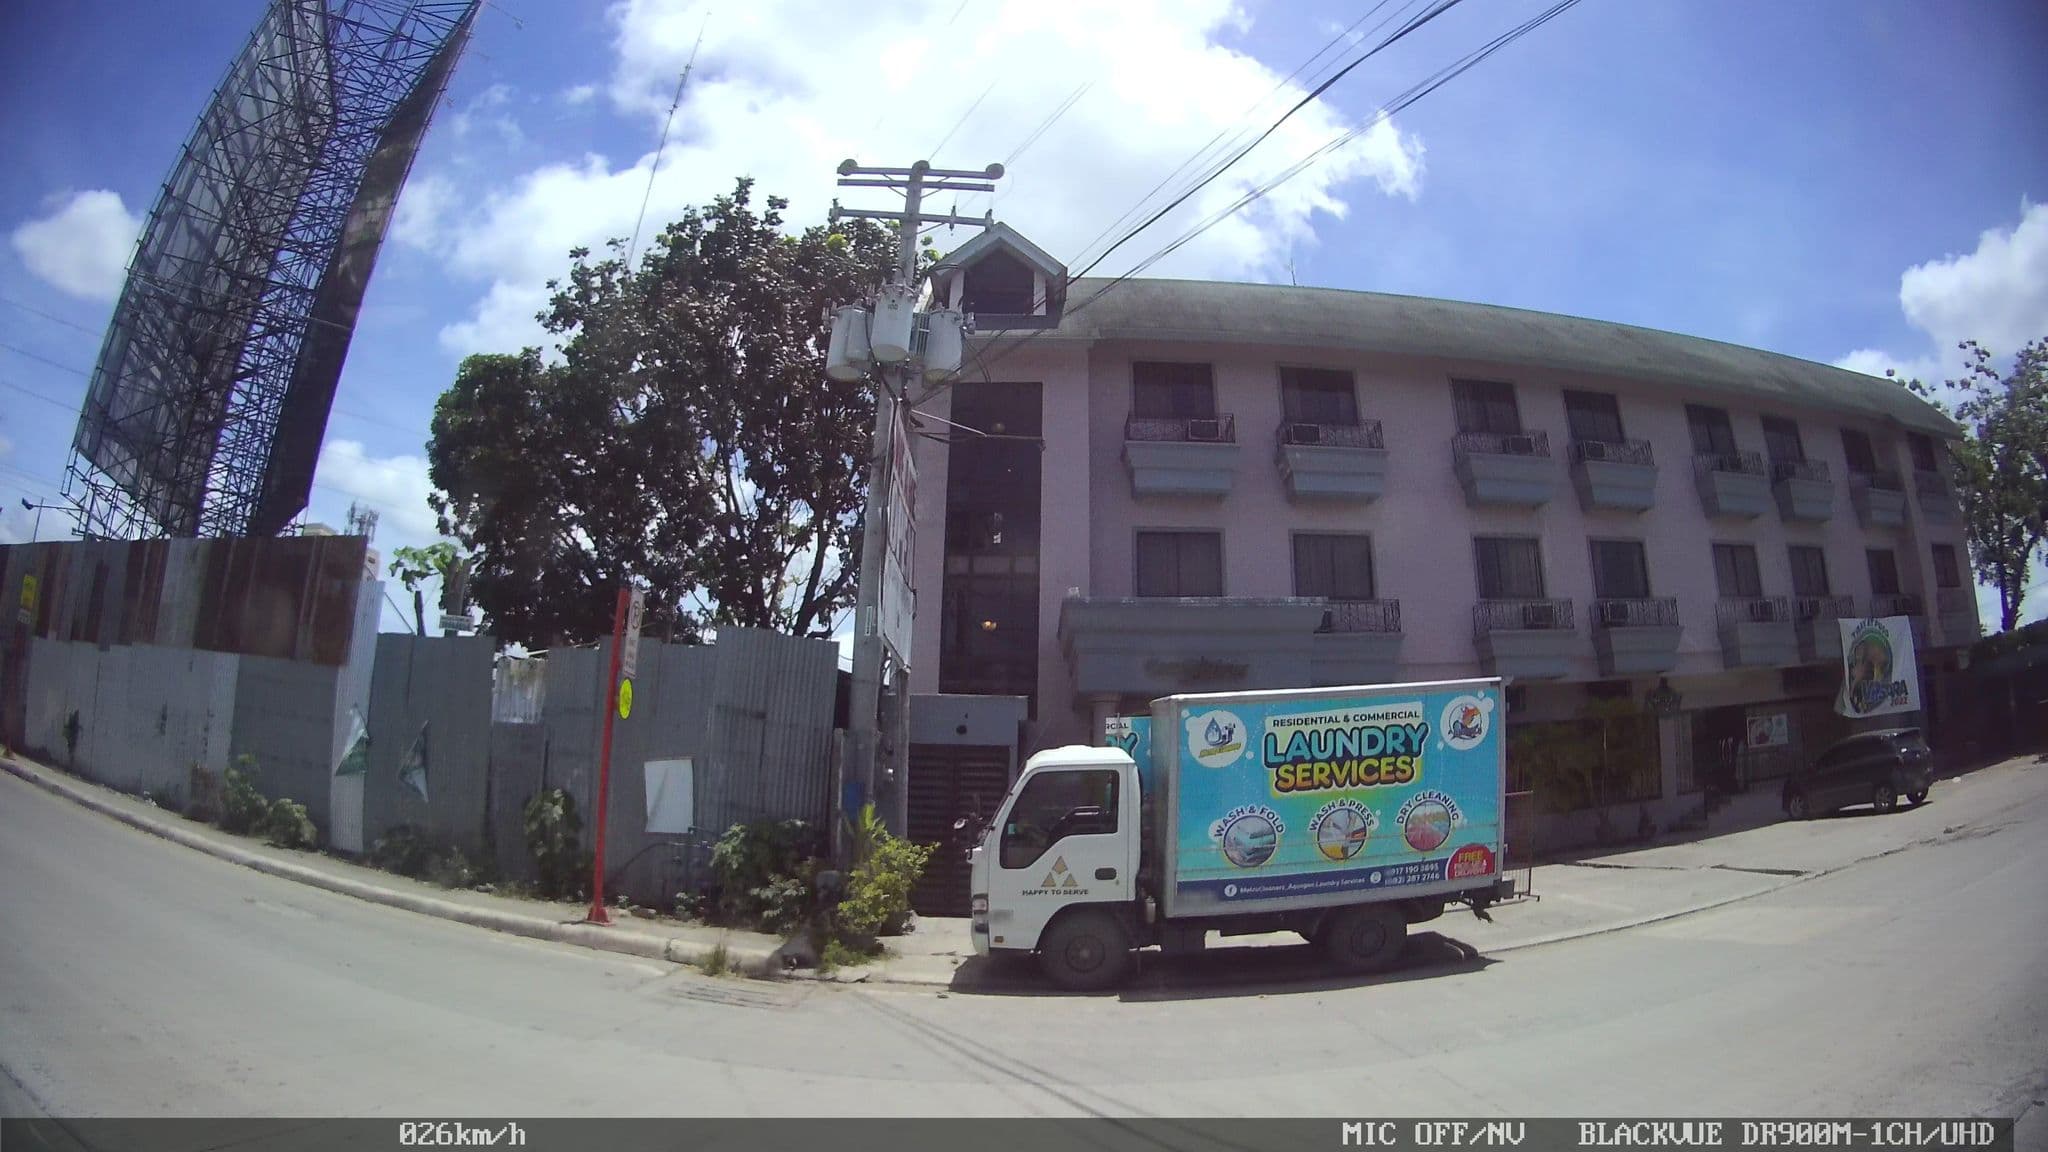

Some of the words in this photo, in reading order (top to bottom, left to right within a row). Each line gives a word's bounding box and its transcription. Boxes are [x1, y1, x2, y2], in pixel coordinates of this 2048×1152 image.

[1272, 715, 1340, 727] RESIDENTIAL
[1343, 715, 1350, 723] &
[1353, 711, 1420, 722] COMMERCIAL
[1265, 723, 1428, 766] LAUNDRY
[1277, 756, 1413, 791] SERVICES
[1214, 807, 1245, 837] WASH
[1248, 806, 1256, 814] &
[1260, 807, 1284, 834] FOLD
[1309, 801, 1336, 831] WASH
[1339, 799, 1346, 807] &
[1348, 800, 1375, 827] PRESS
[1397, 800, 1413, 825] DRY
[1415, 791, 1460, 821] CLEANING
